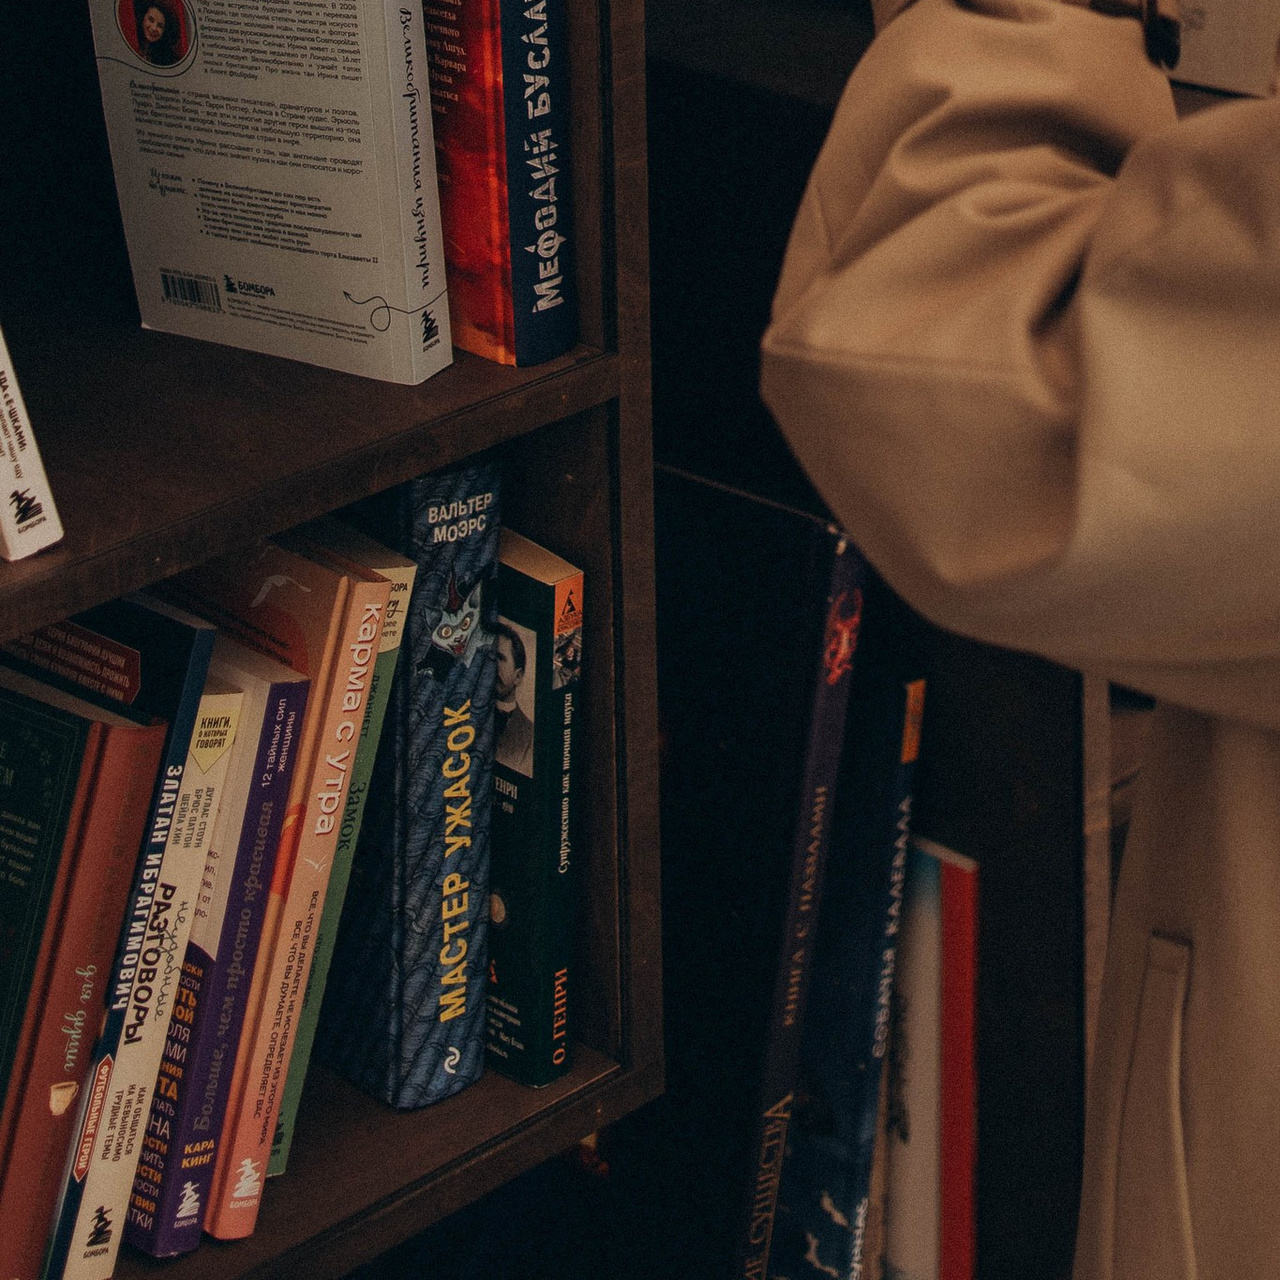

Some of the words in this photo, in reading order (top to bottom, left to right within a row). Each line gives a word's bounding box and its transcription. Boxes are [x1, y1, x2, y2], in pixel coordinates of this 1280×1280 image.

[394, 7, 423, 191] Великобритания
[410, 197, 433, 290] изнутри
[238, 280, 275, 296] БОМБОРА
[429, 492, 493, 526] ВАЛЬТЕР
[433, 515, 486, 546] МОЭРС
[274, 698, 286, 721] сил
[564, 693, 576, 724] наука
[265, 723, 282, 771] тайных
[276, 710, 296, 772] женщины
[562, 728, 572, 769] точная
[262, 772, 272, 787] 12
[308, 746, 351, 838] утра
[442, 698, 475, 857] УЖАСОК
[561, 773, 570, 793] как
[149, 763, 182, 845] ЗЛАТАН
[190, 787, 203, 814] БРЮС
[199, 786, 214, 819] ДУГЛАС
[182, 815, 196, 849] ПАТТОН
[193, 820, 207, 848] СТОУН
[242, 798, 277, 902] красивая
[557, 796, 571, 873] Супружество
[110, 851, 162, 1012] ИБРАГИМОВИЧ
[225, 907, 255, 990] просто
[437, 871, 471, 1023] МАСТЕР
[122, 882, 176, 1047] РАЗГОВОРЫ
[216, 994, 235, 1038] чем
[553, 966, 569, 1040] ГЕНРИ
[55, 1007, 88, 1071] души
[552, 1042, 566, 1064] О.
[84, 1064, 110, 1135] ФУТБОЛЬНЫЕ
[126, 1083, 136, 1096] НА
[135, 1085, 146, 1107] КАК
[193, 1040, 228, 1132] Больше,
[106, 1089, 124, 1131] ТРУДНЫЕ
[111, 1098, 132, 1162] НЕВЫНОСИМО
[76, 1136, 93, 1169] ГЕРОИ
[101, 1132, 114, 1160] ТЕМЫ
[123, 1109, 140, 1155] ОБЩАТЬСЯ
[184, 1134, 215, 1158] КАРА
[181, 1148, 213, 1173] КИНГ
